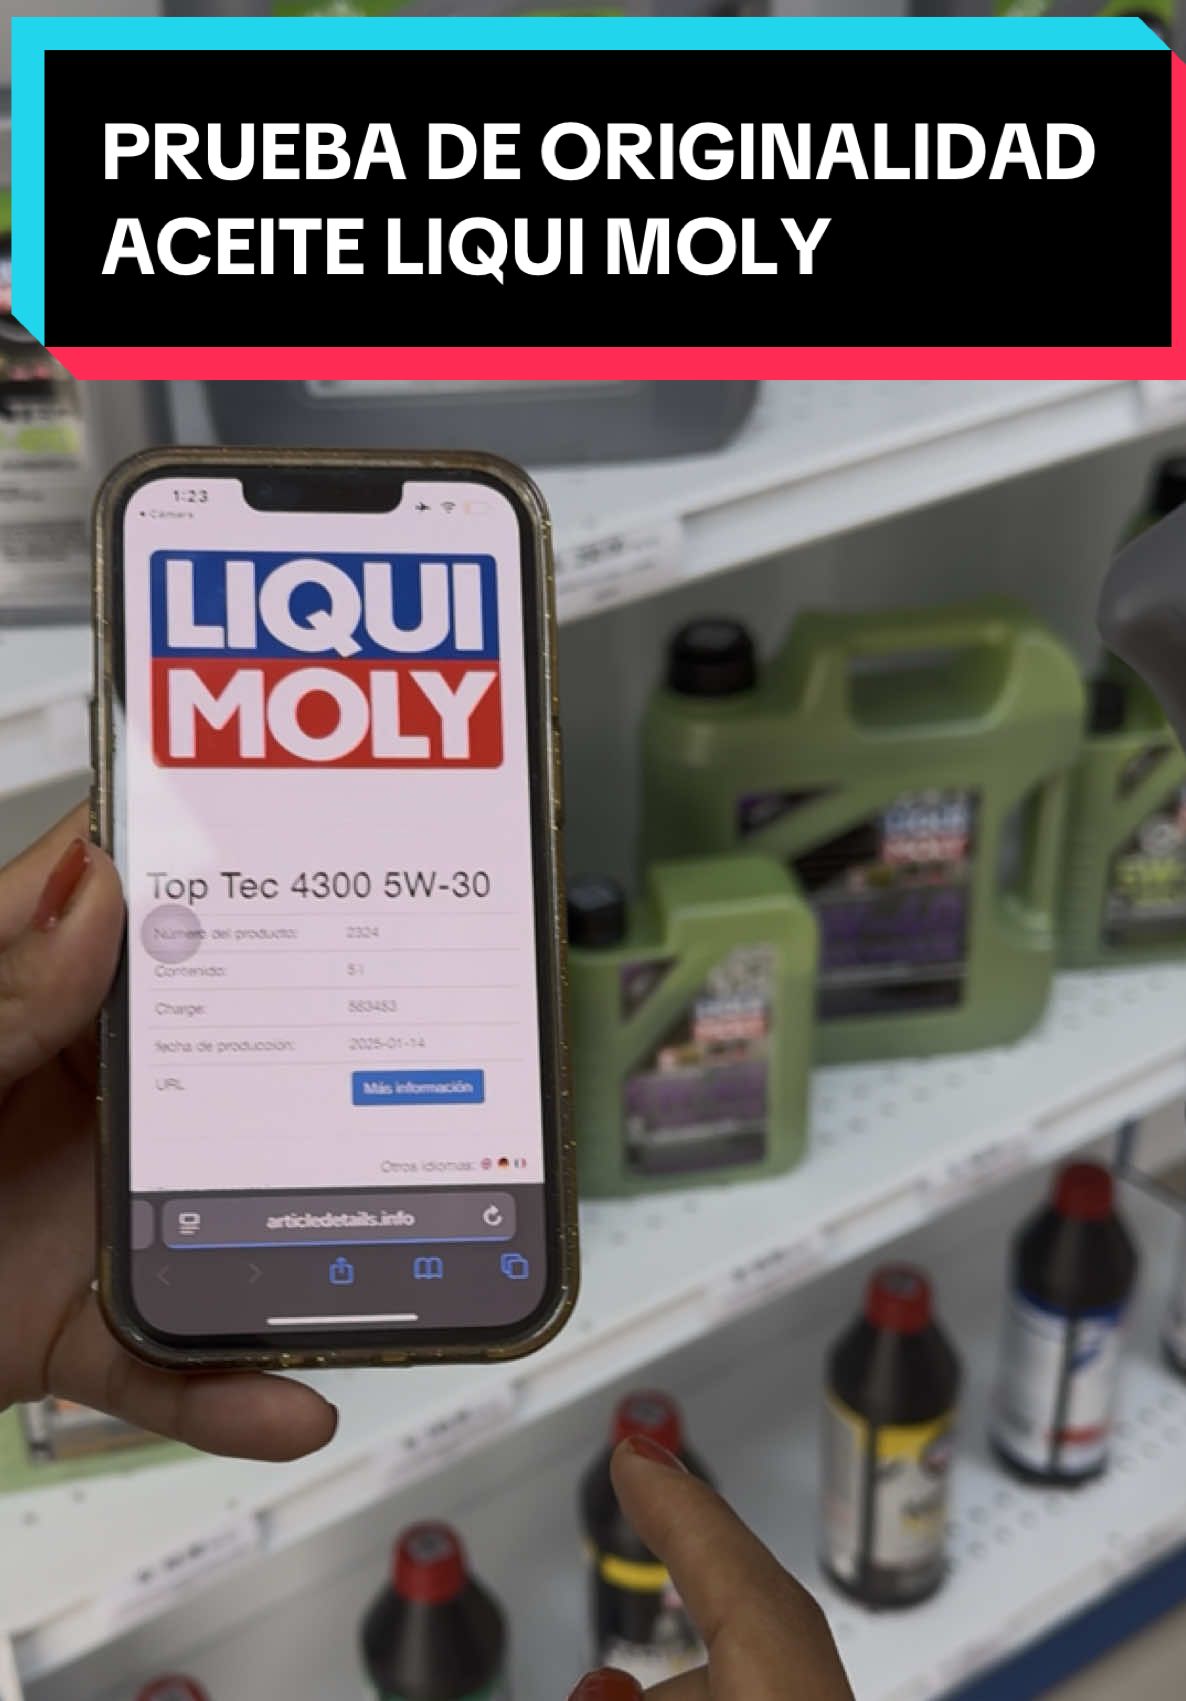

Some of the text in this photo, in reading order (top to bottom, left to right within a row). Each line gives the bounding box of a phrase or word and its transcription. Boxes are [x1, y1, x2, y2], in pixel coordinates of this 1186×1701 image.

[173, 489, 209, 503] 1:23
[165, 558, 485, 659] LIQUI
[167, 667, 498, 762] MOLY
[146, 870, 491, 906] Top Tec 4300 5W-30
[155, 1076, 186, 1092] URL
[362, 1080, 393, 1095] Más
[266, 1209, 416, 1230] articledetails.info
